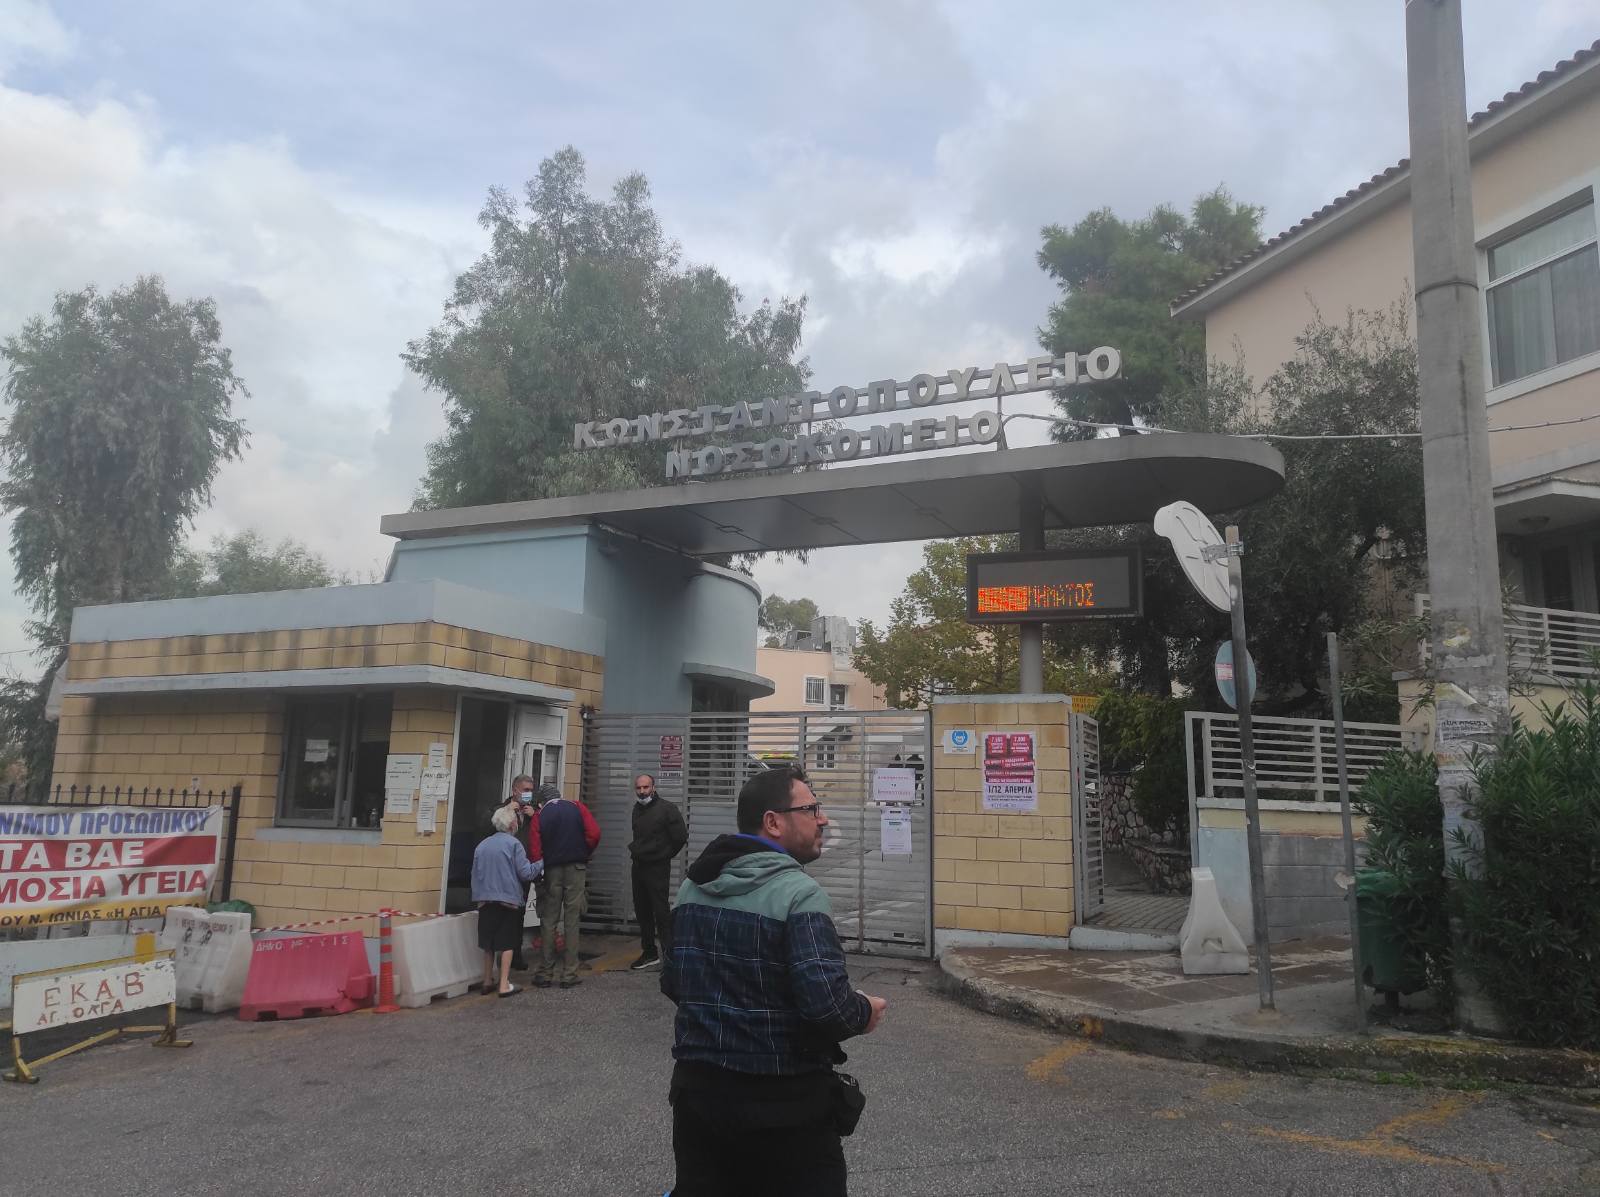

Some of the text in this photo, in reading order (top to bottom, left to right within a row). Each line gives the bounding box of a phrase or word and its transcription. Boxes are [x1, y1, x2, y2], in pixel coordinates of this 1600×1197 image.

[573, 345, 1122, 450] ΚΩΝΣΤΑΝΤΟΠΟΥΛΕΙΟ
[666, 410, 1001, 479] ΝΟΣΟΚΟΜΕΙΟ
[1004, 785, 1033, 795] ΑΠΕΡΓΙΑ
[80, 811, 210, 834] ΠΡΟΣΩΠΙΚΟΥ
[65, 841, 145, 868] ΒΑΕ
[118, 870, 208, 896] ΥΓΕΙΑ
[29, 914, 43, 924] Ν.
[48, 910, 101, 923] ΙΩΝΙΑΣ
[129, 905, 161, 917] ΑΓΙΑ
[44, 971, 145, 1008] ΕΚΑΒ
